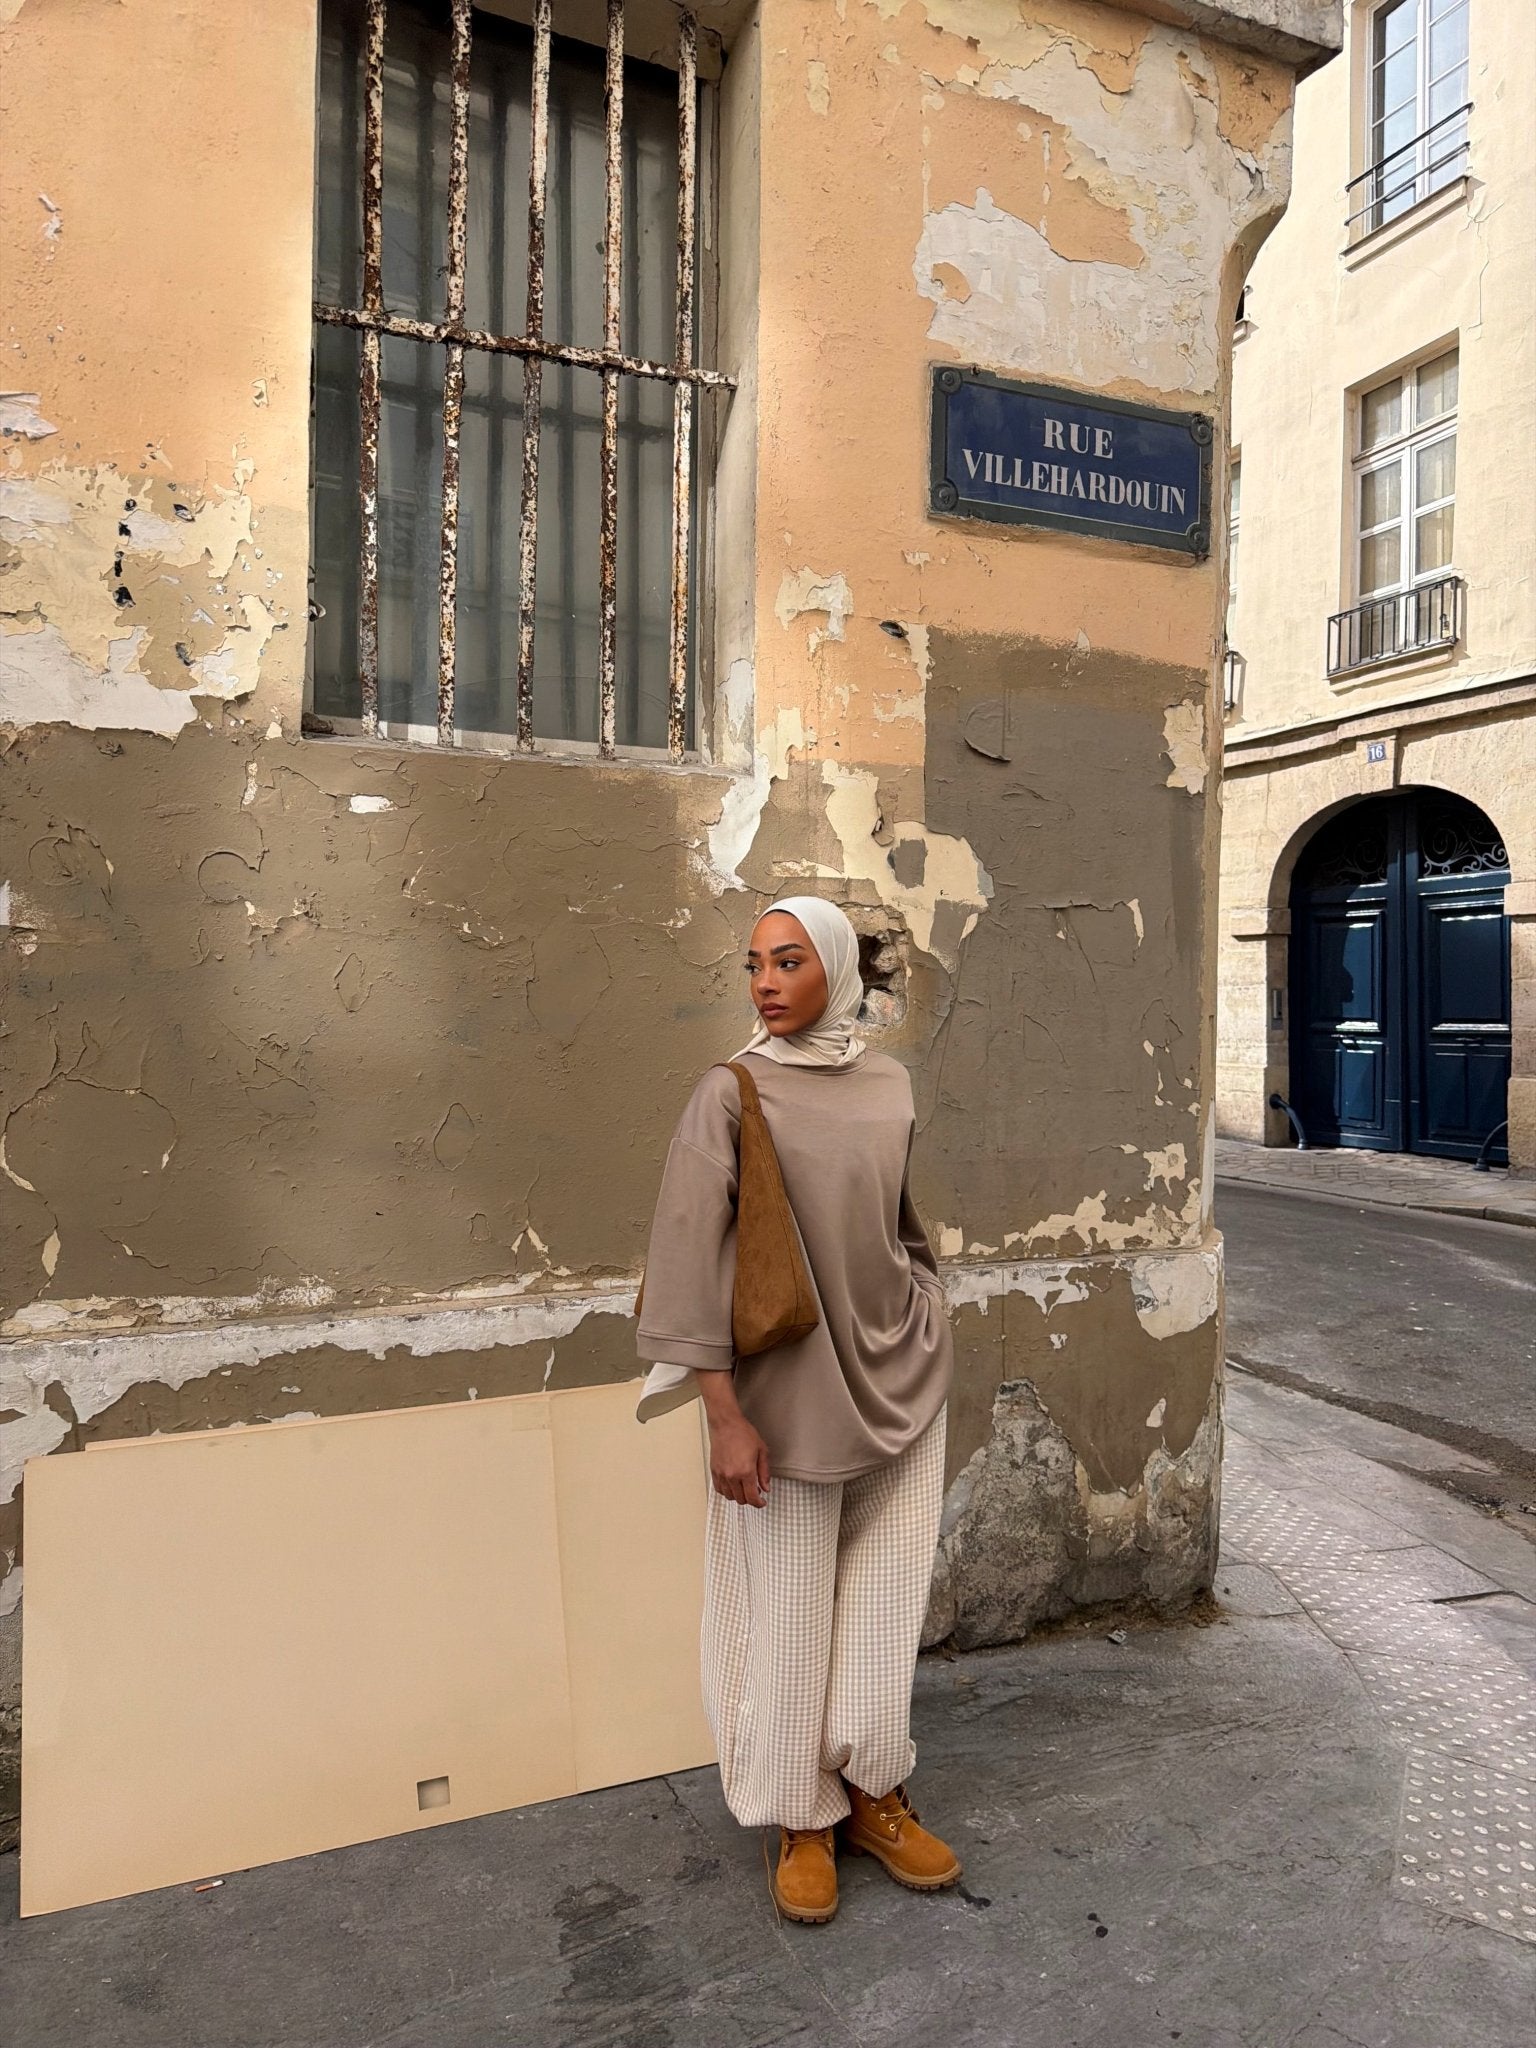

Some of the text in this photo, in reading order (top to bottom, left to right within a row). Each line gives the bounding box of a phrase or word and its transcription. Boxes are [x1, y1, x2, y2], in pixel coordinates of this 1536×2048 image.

[1043, 418, 1113, 459] RUE
[962, 448, 1186, 515] VILLEHARDOUIN
[1369, 745, 1384, 760] 16
